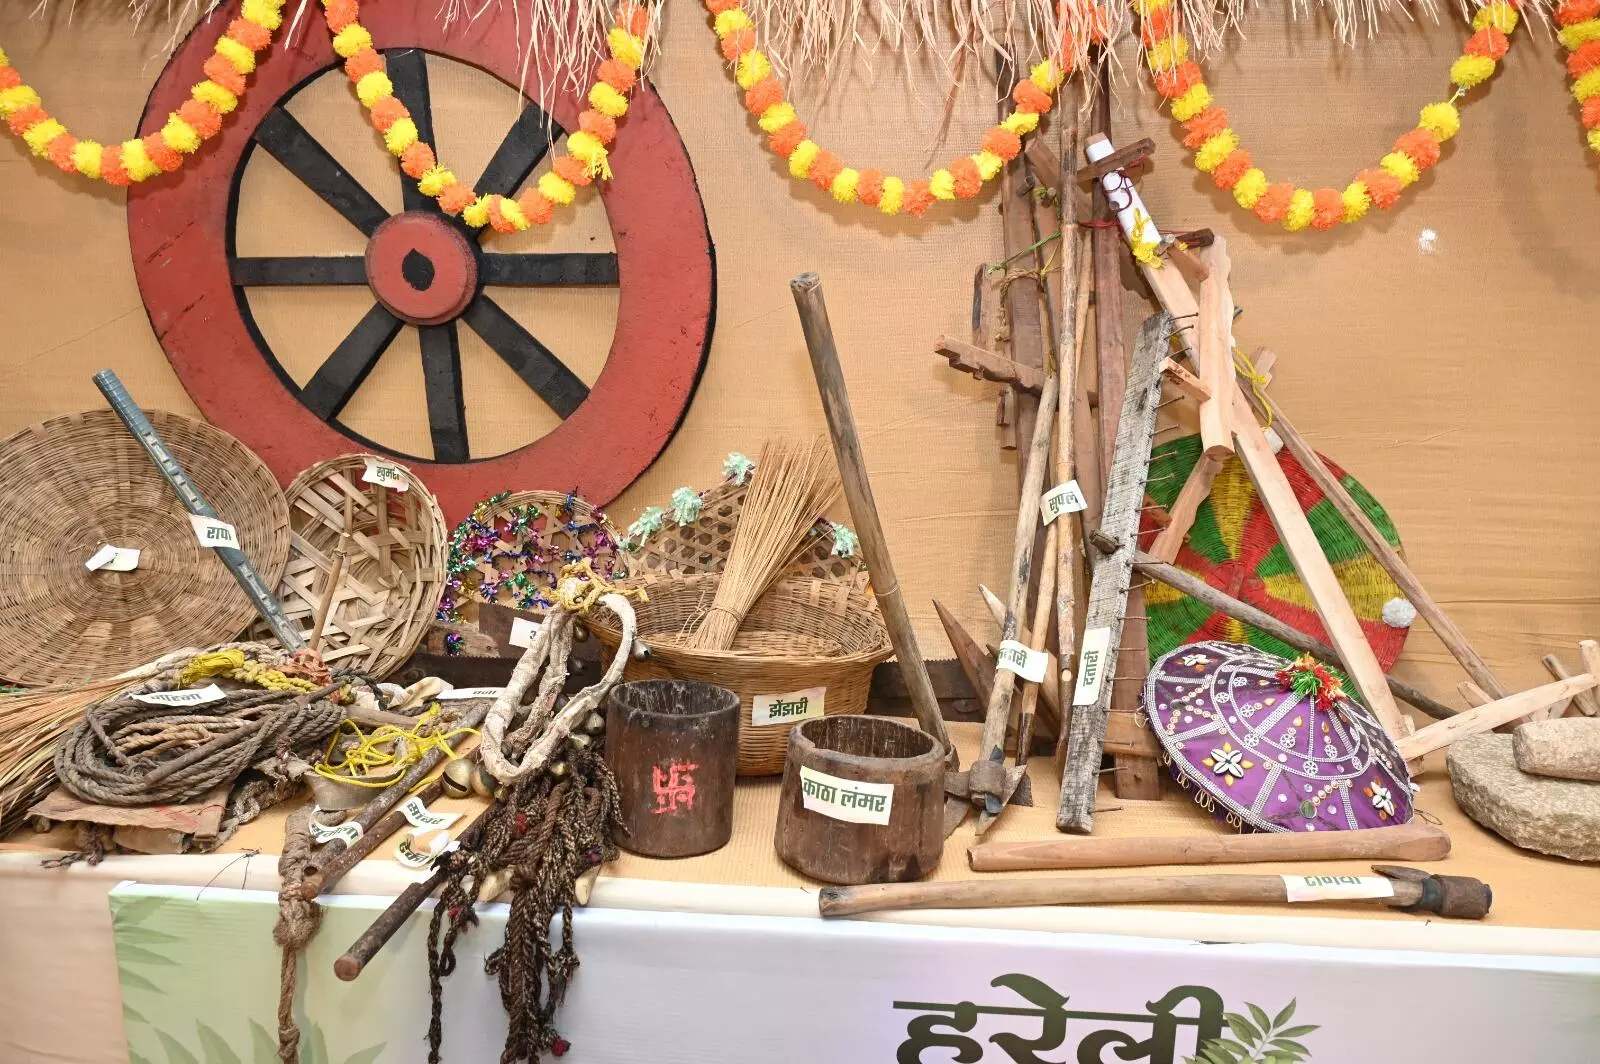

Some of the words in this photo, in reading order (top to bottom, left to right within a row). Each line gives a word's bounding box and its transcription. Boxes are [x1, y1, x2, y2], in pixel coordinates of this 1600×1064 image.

[1083, 650, 1099, 687] दतारी
[768, 696, 809, 719] झेंझरी
[803, 777, 838, 804] काठा
[893, 973, 1232, 1064] हरेली
